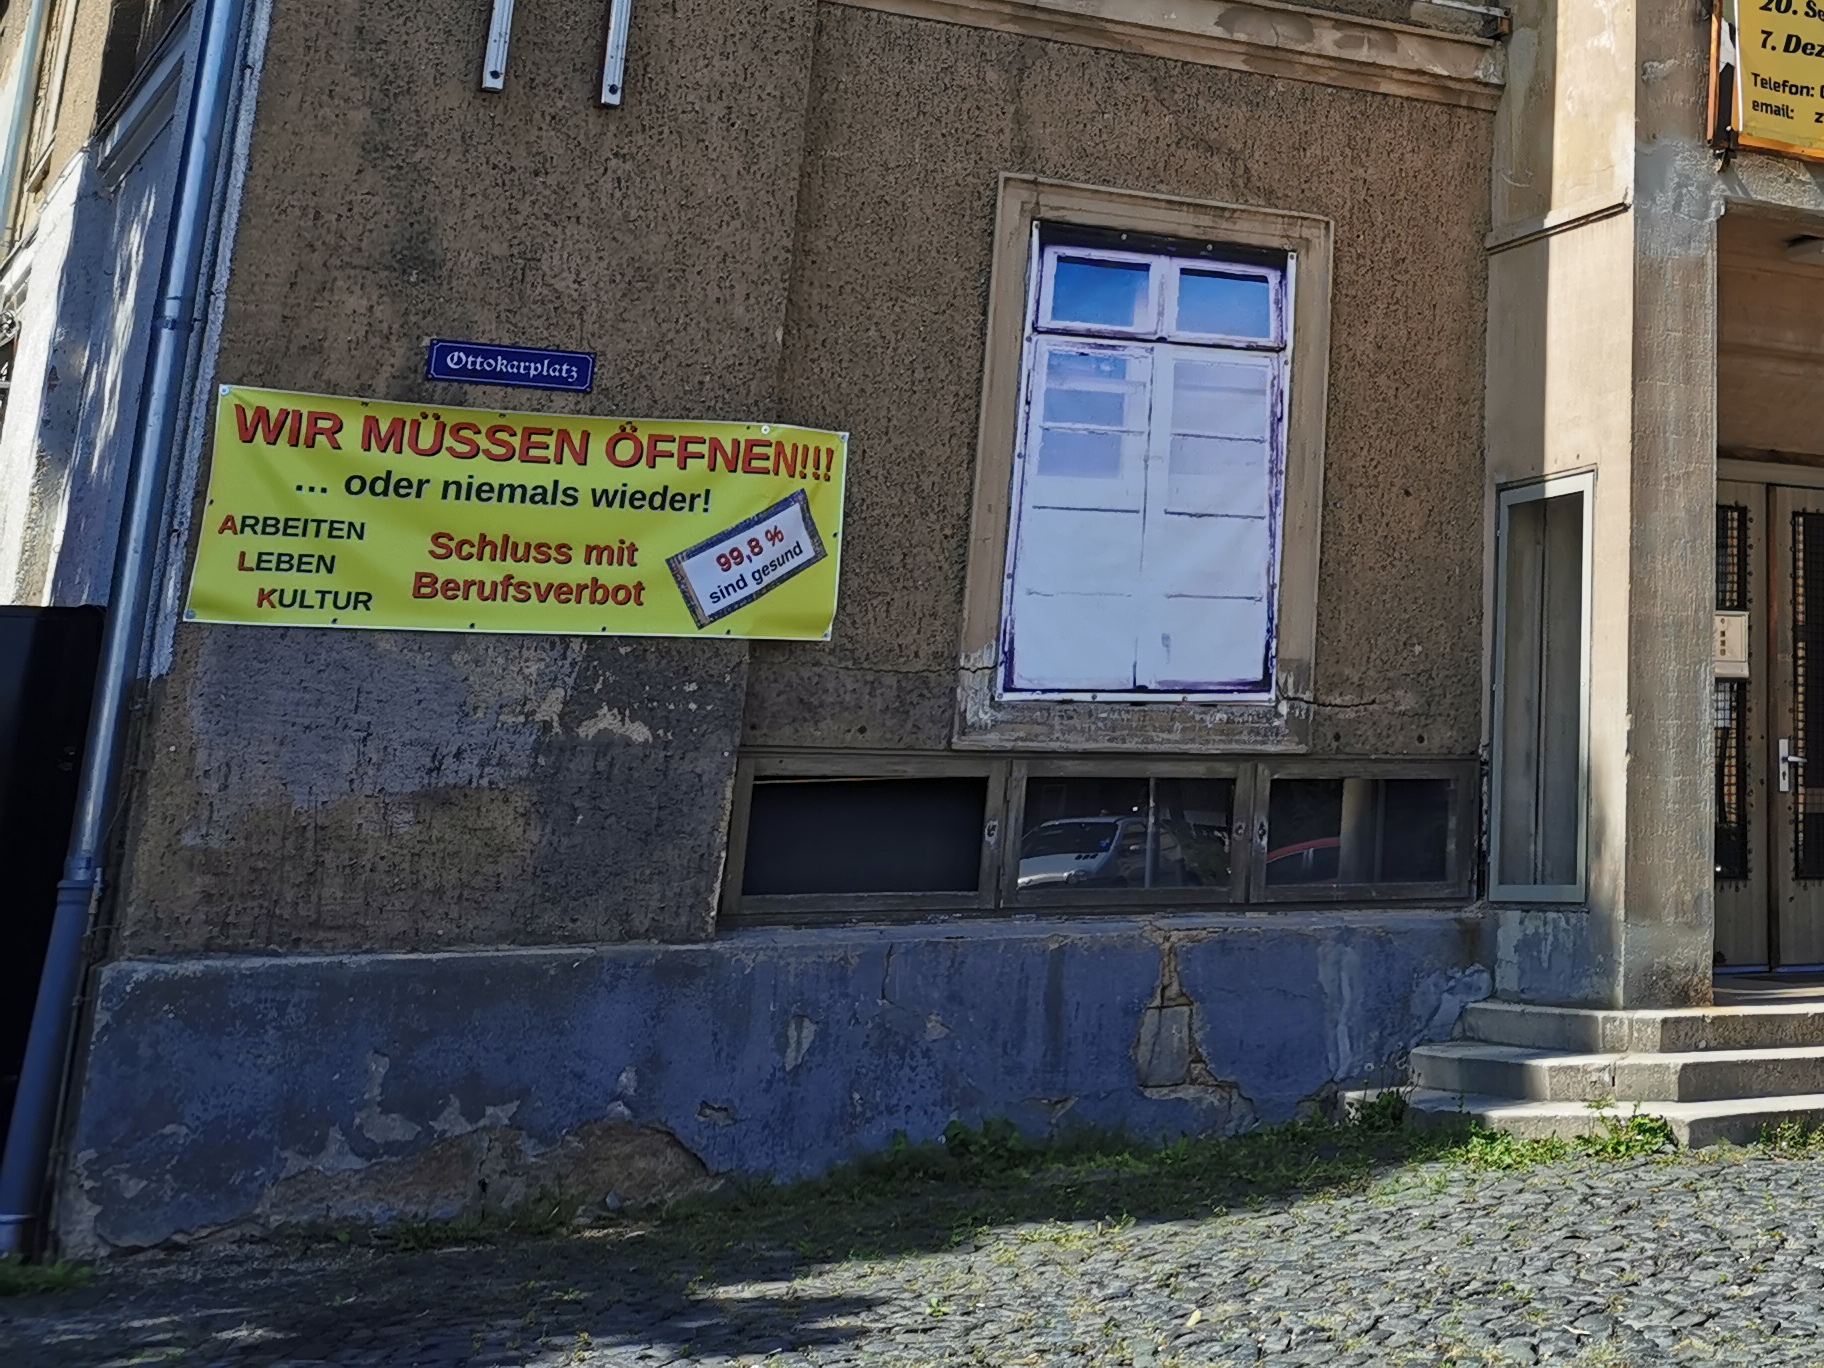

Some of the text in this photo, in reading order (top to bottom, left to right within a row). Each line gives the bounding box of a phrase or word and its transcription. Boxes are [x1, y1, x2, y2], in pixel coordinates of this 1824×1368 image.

[1760, 29, 1777, 52] 7.
[1751, 72, 1815, 98] Telefon:
[1752, 99, 1795, 120] email:
[446, 350, 579, 382] Ottokarplatz
[234, 403, 835, 482] WIR MÜSSEN ÖFFNEN!!!
[344, 470, 431, 499] oder
[441, 474, 580, 508] niemals
[591, 483, 712, 513] wieder!
[217, 514, 366, 541] ARBEITEN
[237, 551, 336, 574] LEBEN
[428, 532, 639, 567] Schluss mit
[715, 524, 785, 573] 99,8 %
[412, 571, 646, 607] Berufsverbot
[708, 541, 804, 605] sind gesund
[256, 587, 373, 612] KULTUR
